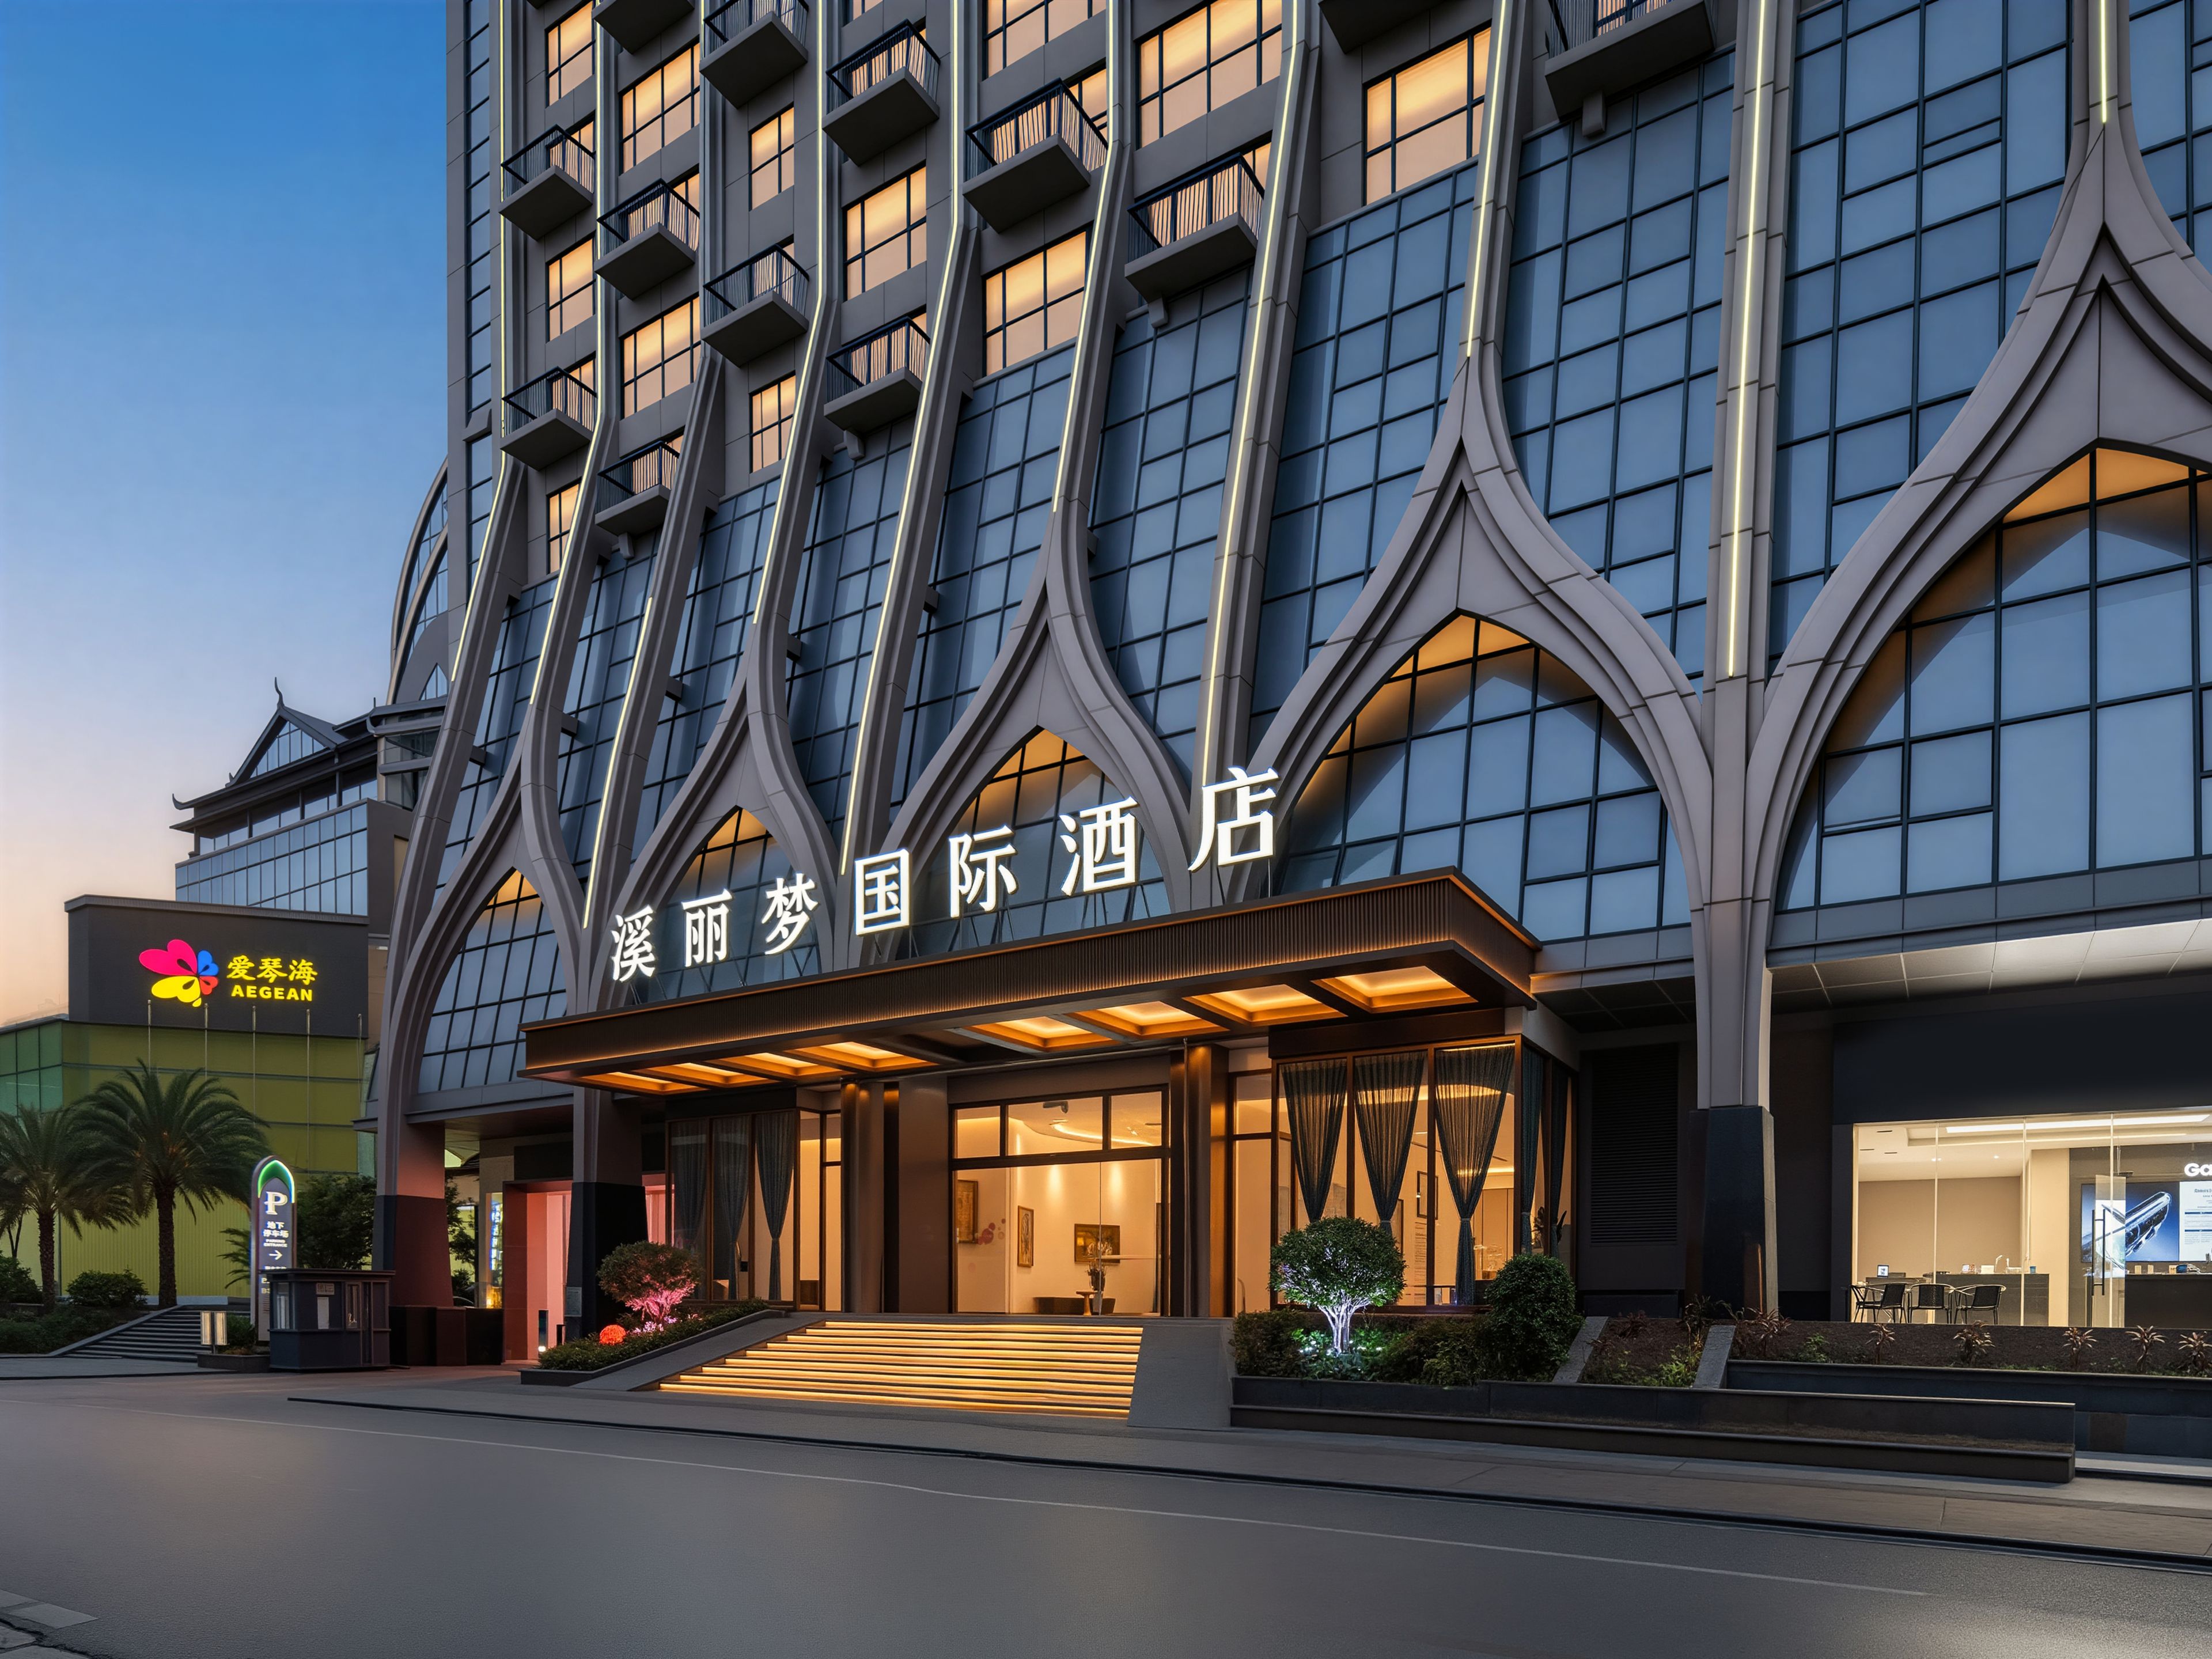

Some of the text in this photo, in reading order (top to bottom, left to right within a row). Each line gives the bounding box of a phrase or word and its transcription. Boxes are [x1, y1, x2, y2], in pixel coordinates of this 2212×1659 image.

[611, 767, 1279, 982] 溪丽梦国际酒店
[226, 955, 318, 985] 爱琴海
[231, 984, 313, 1002] AEGEAN
[264, 1191, 288, 1215] P
[263, 1229, 289, 1238] 停车场
[267, 1221, 285, 1229] 地下
